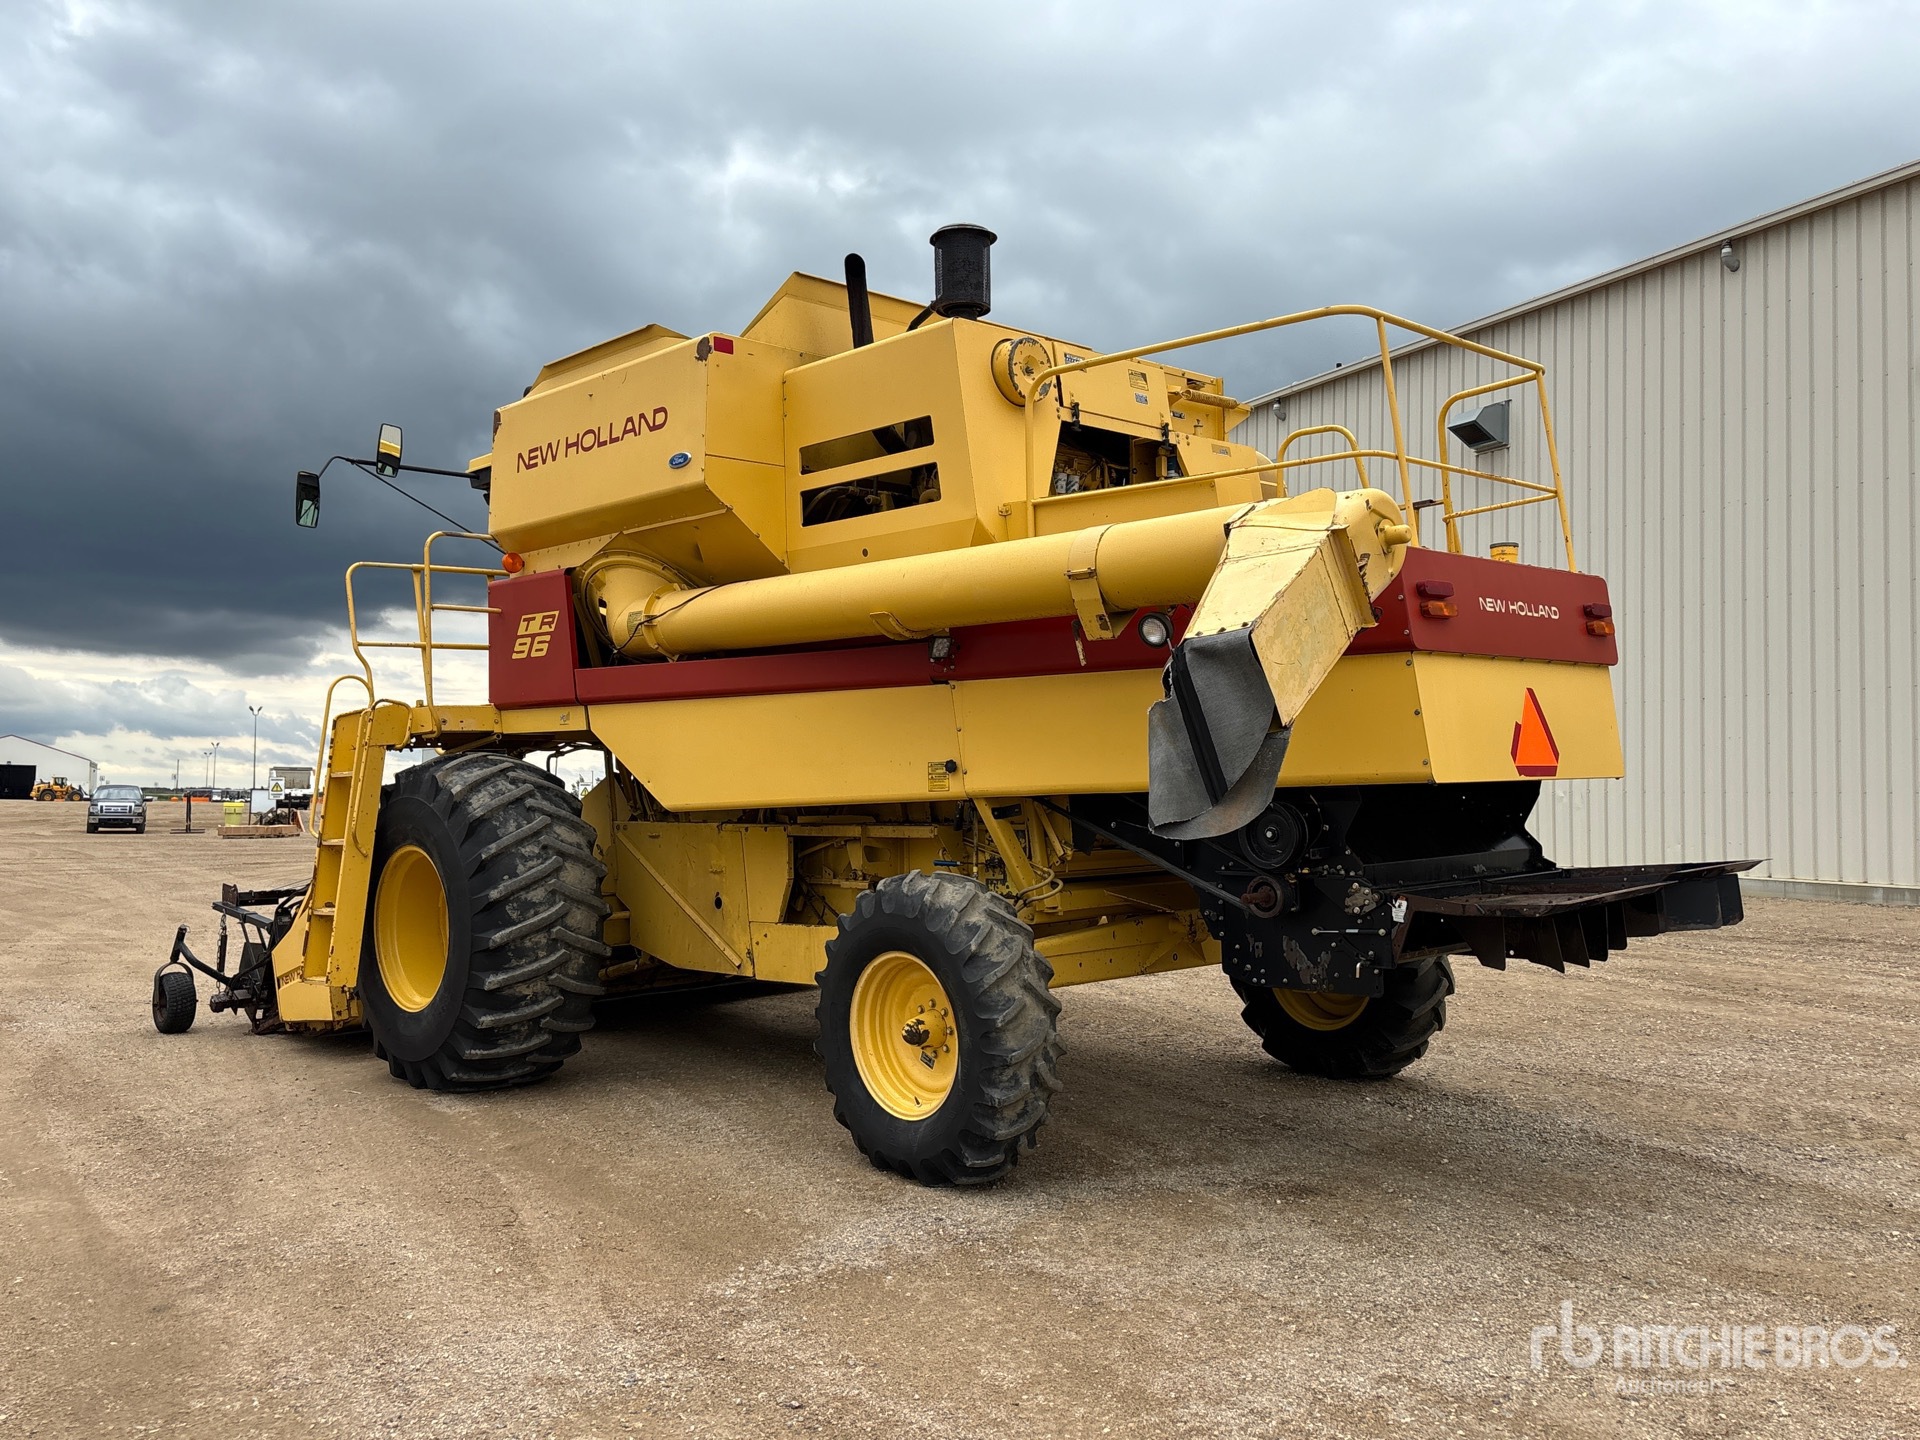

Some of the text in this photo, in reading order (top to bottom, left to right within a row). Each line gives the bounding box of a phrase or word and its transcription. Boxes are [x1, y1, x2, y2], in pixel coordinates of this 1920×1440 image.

[516, 406, 669, 474] NEW HOLLAND
[1478, 596, 1560, 620] NEW HOLLAND
[520, 613, 558, 632] TR
[512, 635, 551, 660] 96
